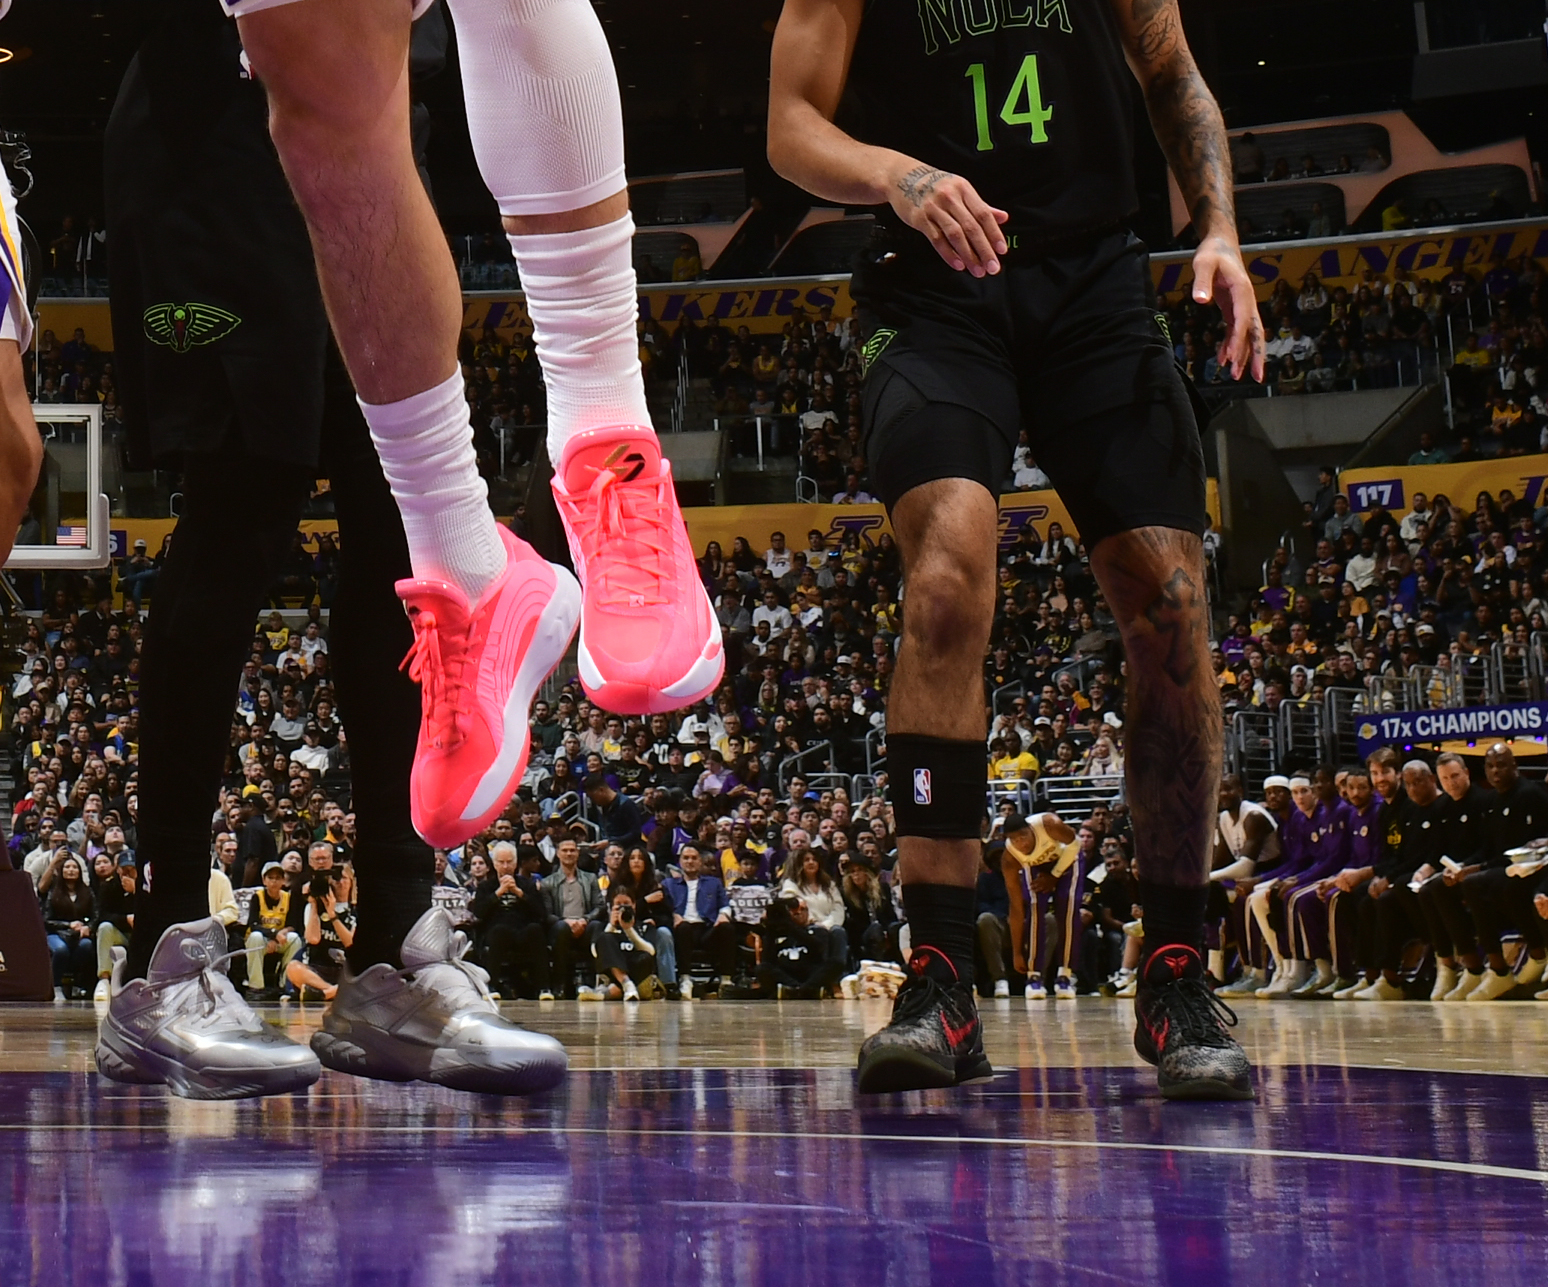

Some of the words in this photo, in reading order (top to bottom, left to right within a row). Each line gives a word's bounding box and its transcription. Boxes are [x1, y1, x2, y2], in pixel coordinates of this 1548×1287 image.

[963, 53, 1055, 153] 14
[1356, 484, 1393, 508] 117
[1380, 717, 1412, 738] 17x
[1414, 705, 1543, 735] CHAMPIONS
